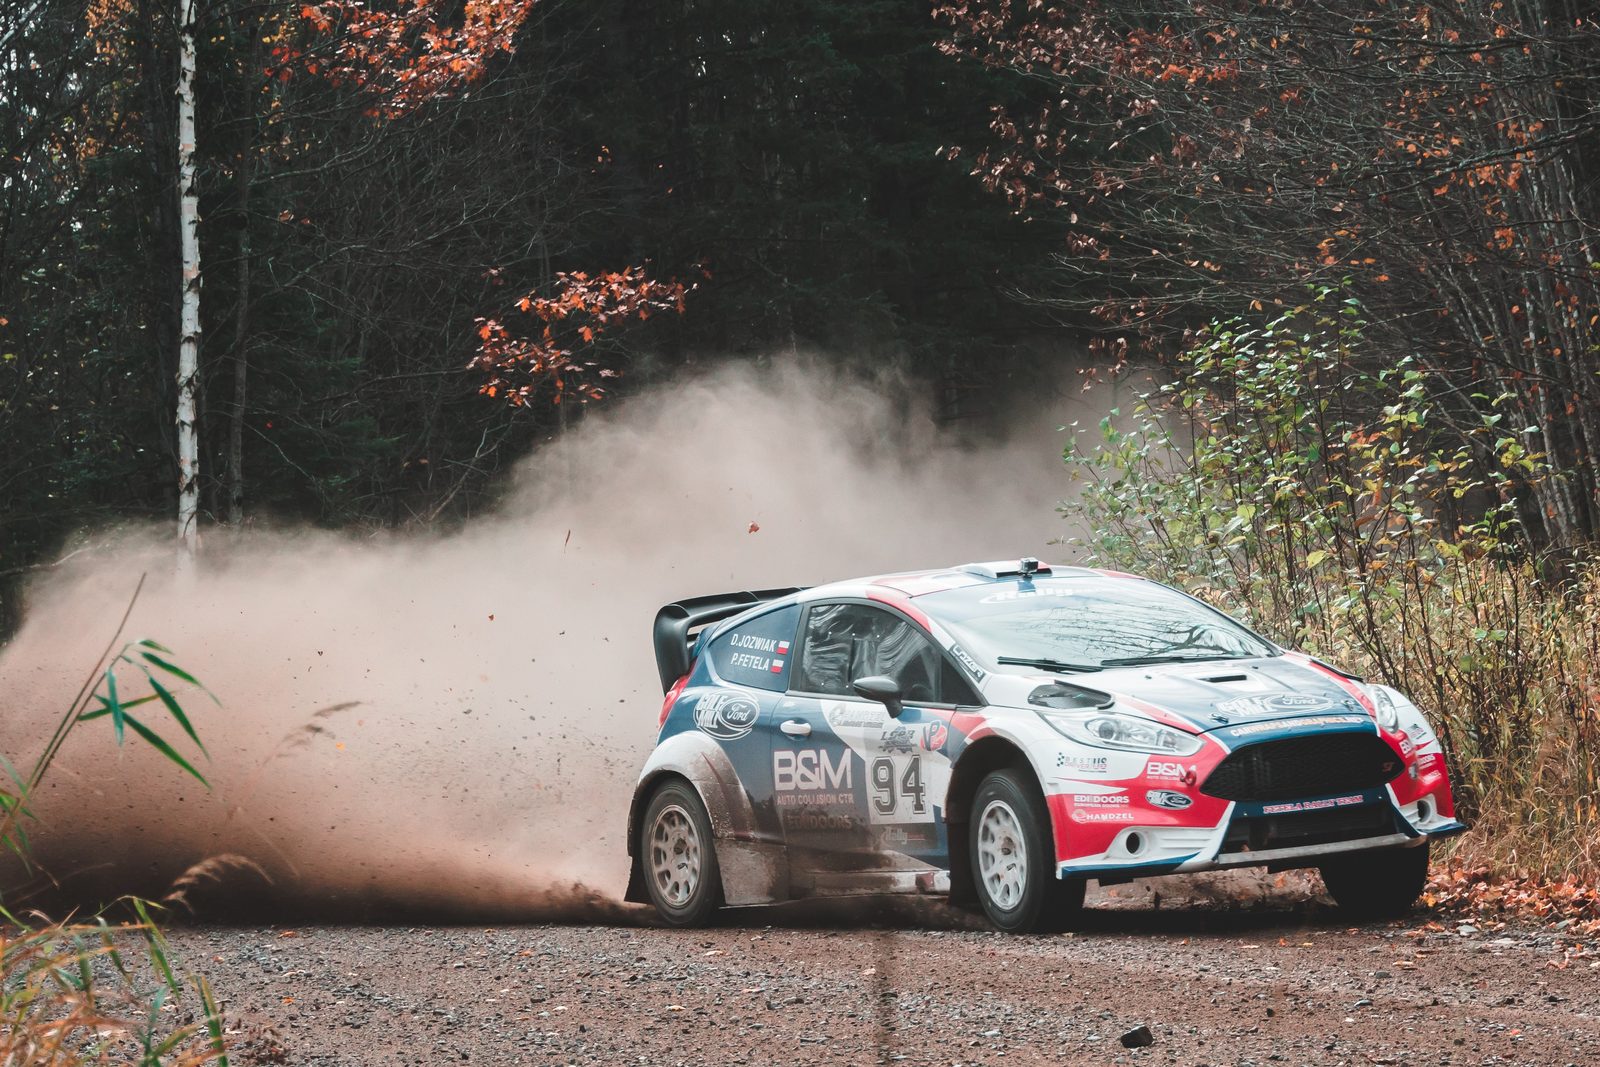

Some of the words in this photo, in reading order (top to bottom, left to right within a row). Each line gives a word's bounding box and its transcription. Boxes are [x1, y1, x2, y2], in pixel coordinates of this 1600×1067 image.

[730, 633, 777, 652] D.JOZWIAK
[730, 652, 770, 671] P.FETELA
[1281, 695, 1318, 705] Ford
[726, 702, 751, 722] Ford
[773, 748, 853, 791] B&M
[871, 753, 926, 816] 94
[776, 794, 797, 806] AUTO
[797, 793, 838, 805] COLLISION
[838, 792, 855, 804] CTR
[1086, 812, 1135, 821] HANDZEL
